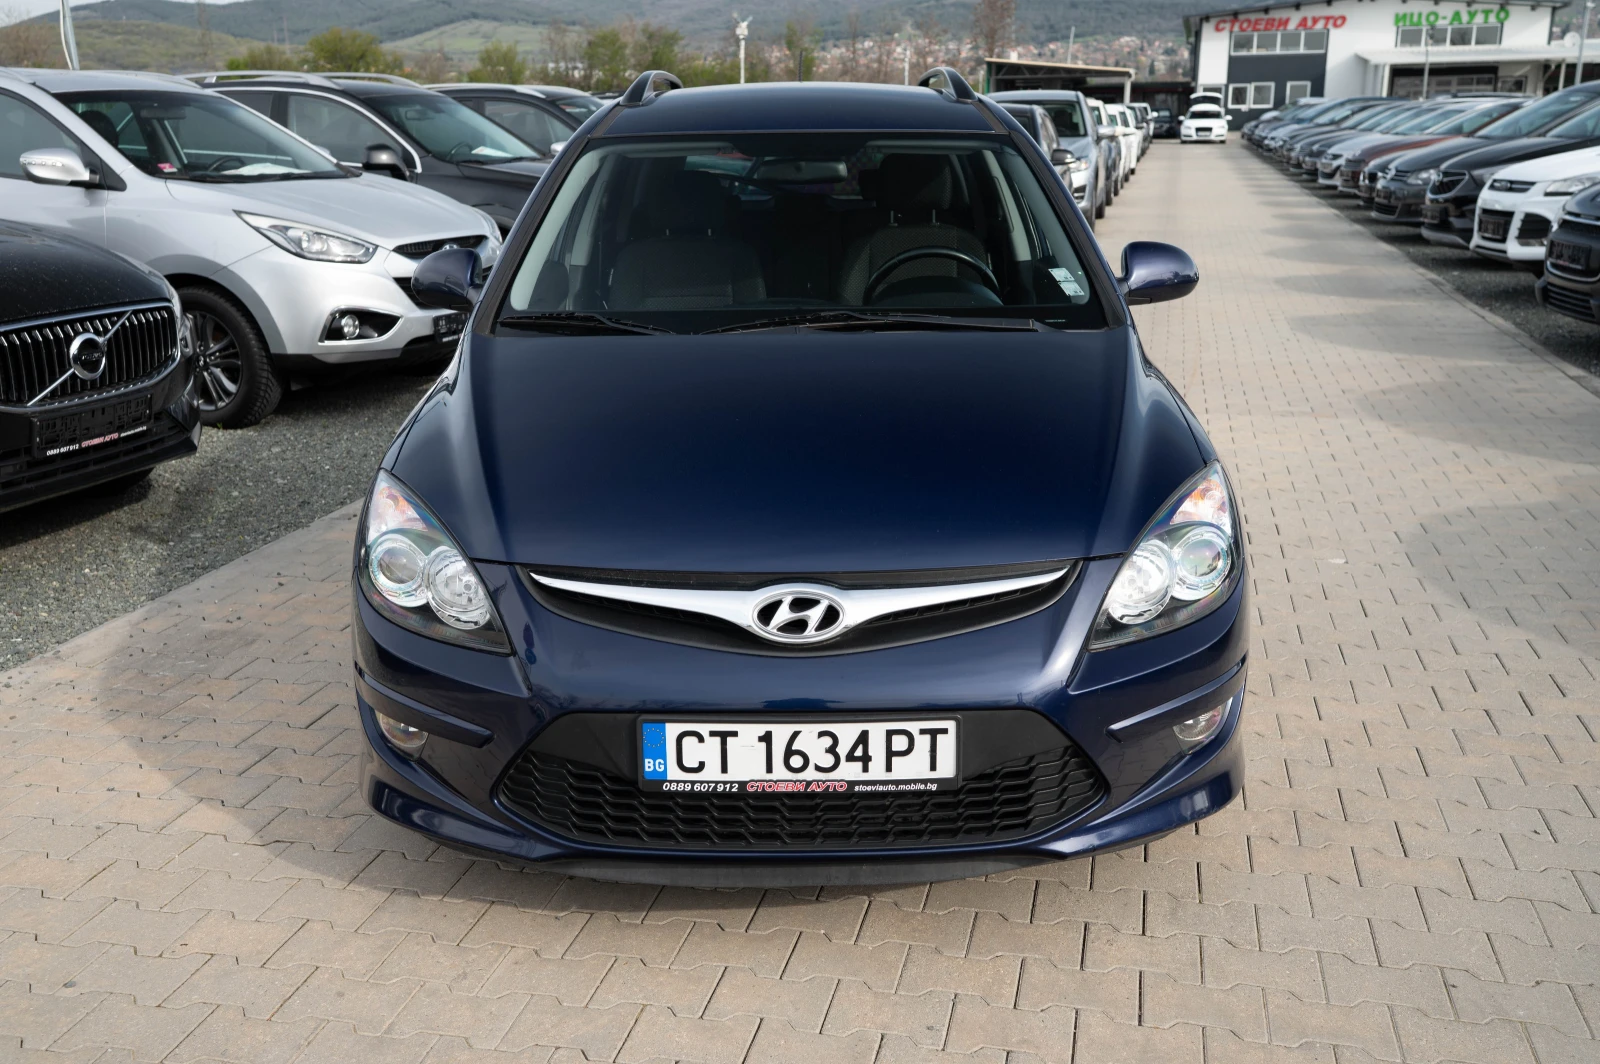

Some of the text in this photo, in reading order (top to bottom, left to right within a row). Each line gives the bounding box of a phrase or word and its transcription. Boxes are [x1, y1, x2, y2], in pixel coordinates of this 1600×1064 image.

[1214, 15, 1347, 32] СТОЕВИ АУТО
[1394, 8, 1510, 26] ИЦО-АУТО
[644, 758, 665, 772] BG
[662, 781, 938, 792] 0889 607 912 СТОЕВИ АУТО stoeviauto.mobile.bg
